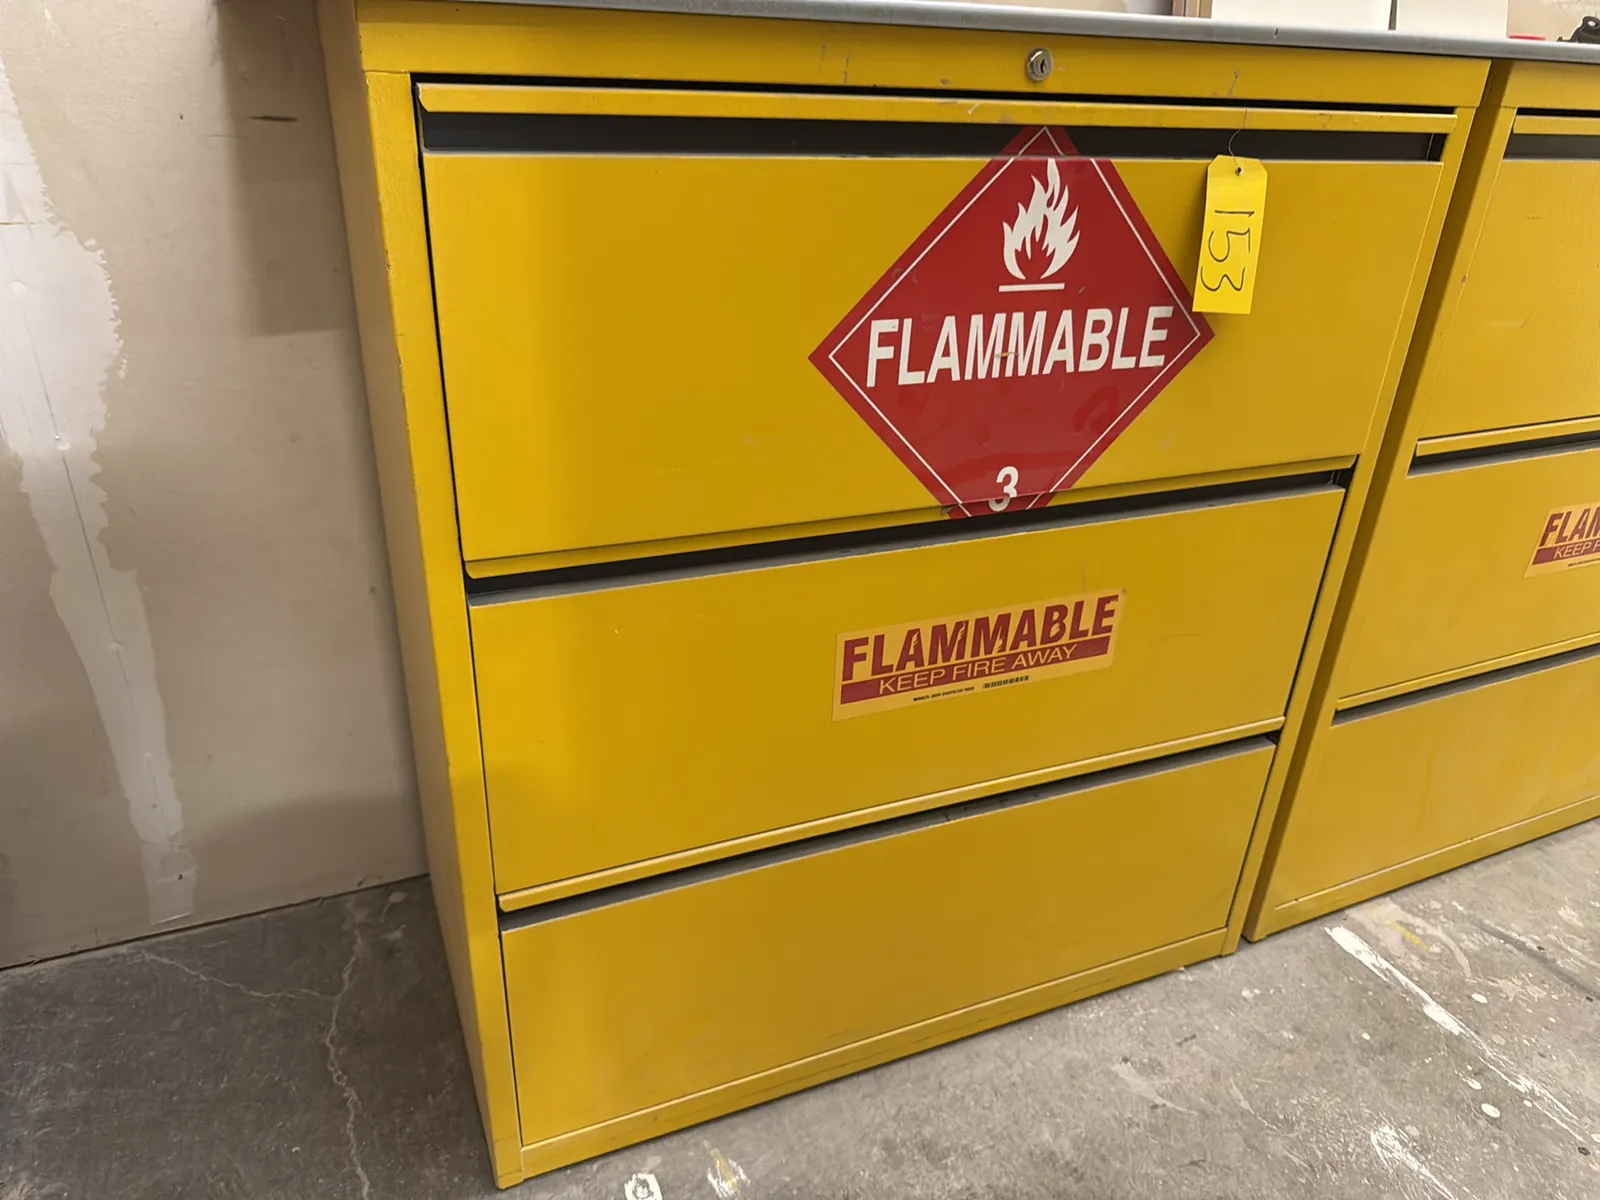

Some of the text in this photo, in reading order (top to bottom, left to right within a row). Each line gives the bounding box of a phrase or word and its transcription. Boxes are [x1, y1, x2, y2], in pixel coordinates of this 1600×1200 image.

[1200, 208, 1255, 293] 153
[865, 305, 1174, 388] FLAMMABLE
[988, 466, 1019, 513] 3
[1553, 541, 1593, 560] KEEP
[842, 594, 1120, 682] FLAMMABLE
[879, 668, 946, 695] KEEP
[951, 659, 1006, 681] FIRE
[1010, 644, 1077, 671] AWAY
